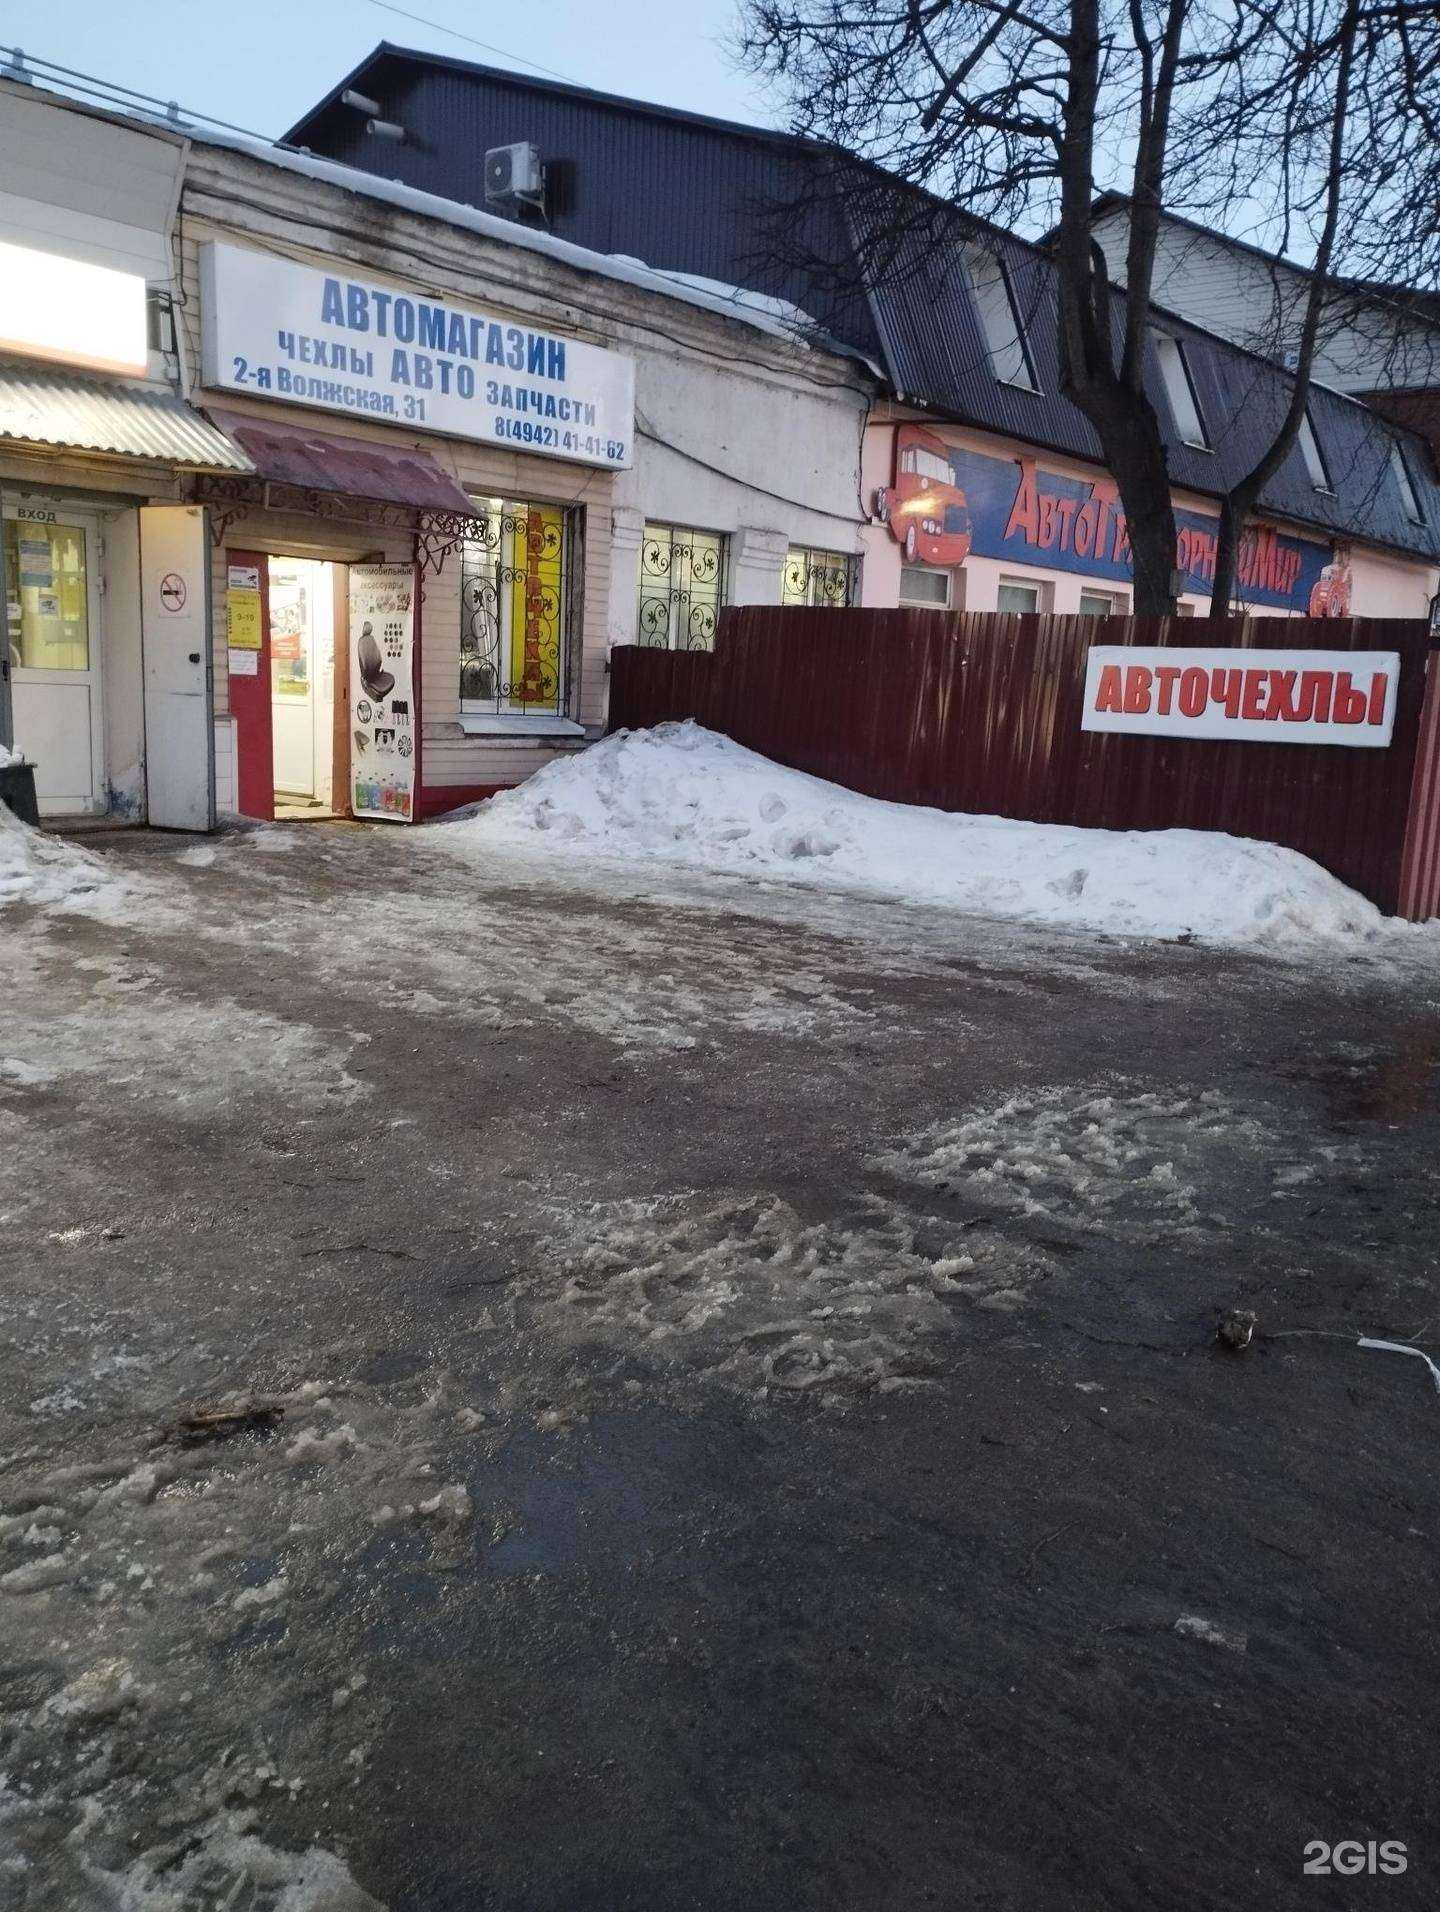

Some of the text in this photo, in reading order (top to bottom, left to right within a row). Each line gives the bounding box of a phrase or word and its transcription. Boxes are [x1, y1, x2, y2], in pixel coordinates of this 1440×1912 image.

[321, 278, 566, 382] АВТОМАГАЗИН
[233, 356, 425, 421] 2-я Волжская, 31
[278, 330, 596, 427] ЧЕХЛЫ АВТО ЗАПЧАСТИ
[494, 416, 625, 461] 8(4942) 41-41-62
[18, 508, 57, 524] ВХОД
[1094, 665, 1389, 725] АВТОЧЕХЛЫ
